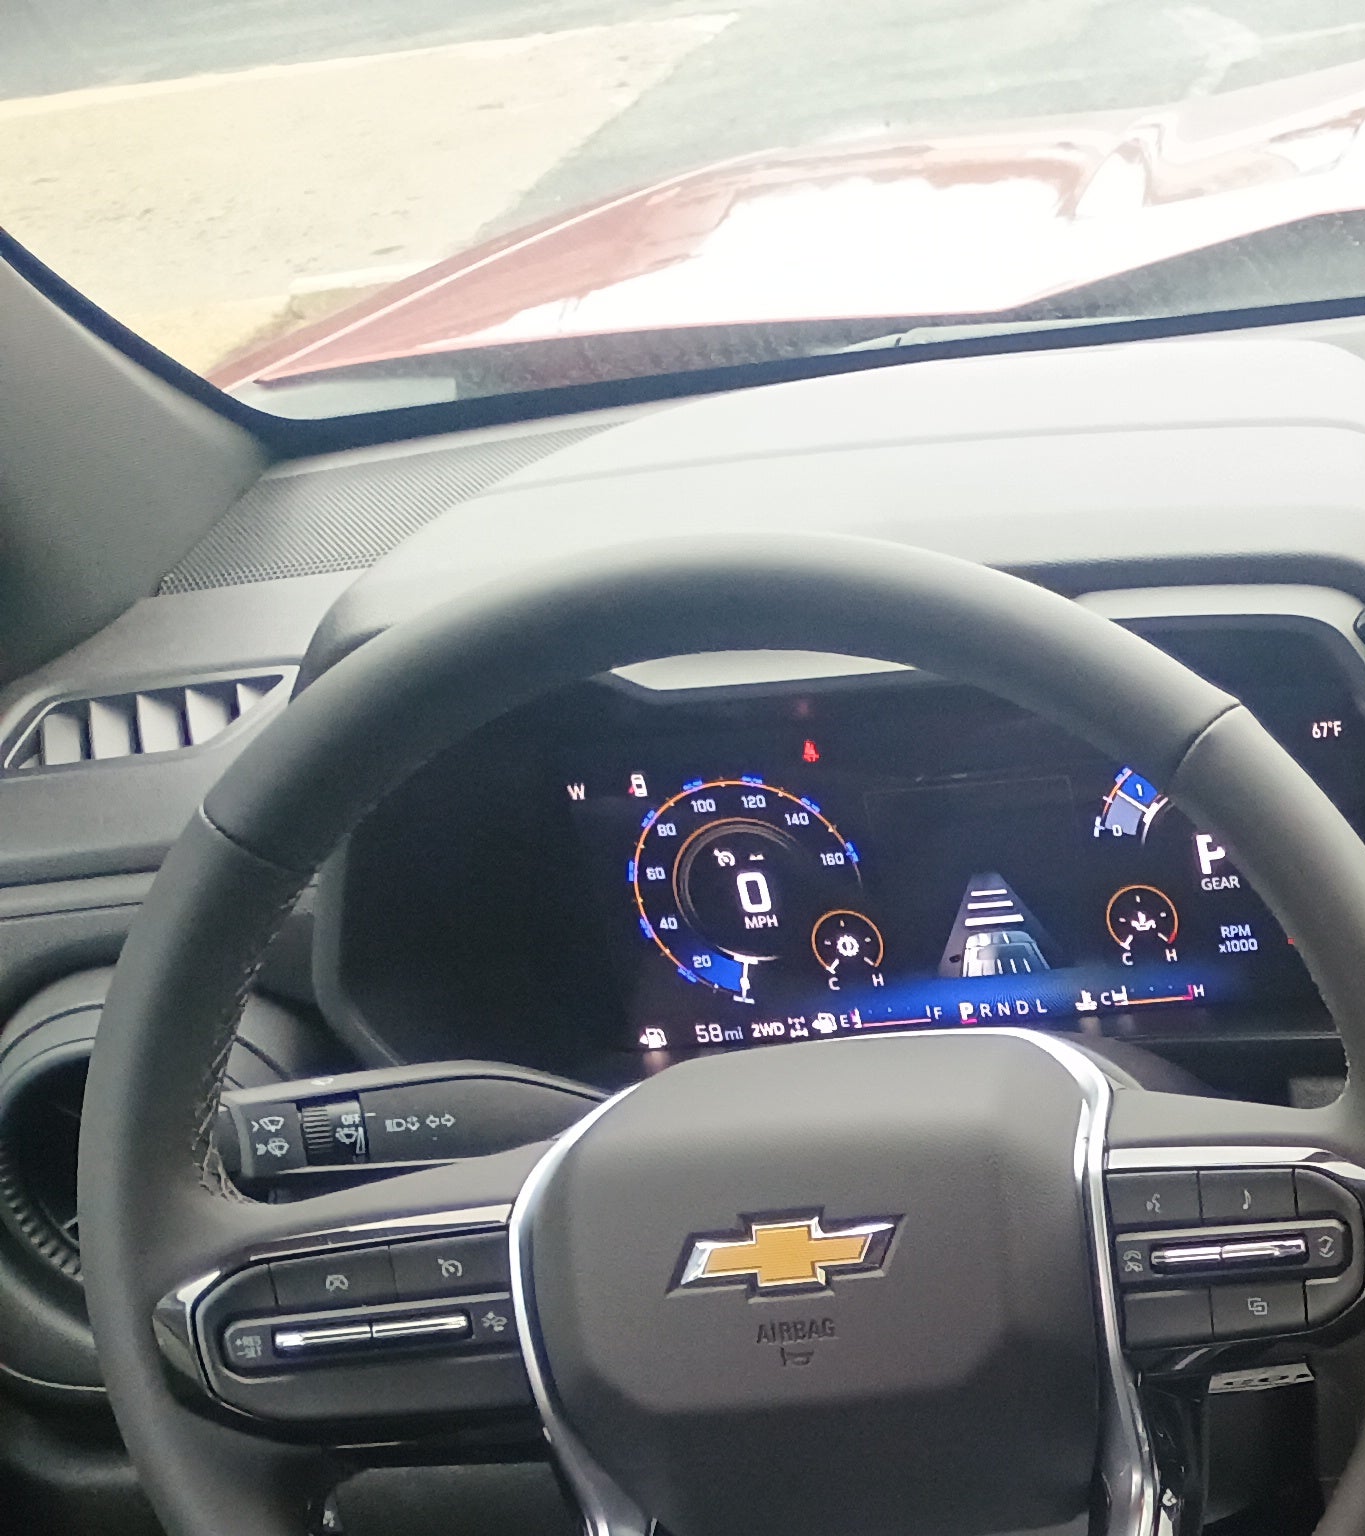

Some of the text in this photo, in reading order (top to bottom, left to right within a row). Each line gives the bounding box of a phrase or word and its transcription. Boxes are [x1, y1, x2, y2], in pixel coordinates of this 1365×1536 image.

[1311, 720, 1343, 739] 67°F
[566, 783, 586, 801] W
[690, 799, 717, 813] 100
[740, 795, 767, 809] 120
[784, 812, 810, 826] 140
[656, 823, 677, 837] 80
[820, 852, 845, 866] 160
[646, 867, 666, 881] 60
[1200, 875, 1240, 892] GEAR
[736, 871, 772, 914] 0
[659, 917, 678, 931] 40
[744, 915, 779, 930] MPH
[1220, 925, 1252, 938] RPM
[1218, 938, 1259, 953] x1000
[692, 954, 712, 969] 20
[1121, 952, 1133, 966] C
[1165, 949, 1178, 962] H
[827, 977, 840, 991] C
[871, 974, 885, 988] H
[1193, 985, 1205, 997] H
[960, 999, 1047, 1018] P R N D L
[750, 1021, 785, 1038] 2WD
[756, 1317, 836, 1345] AIRBAG
